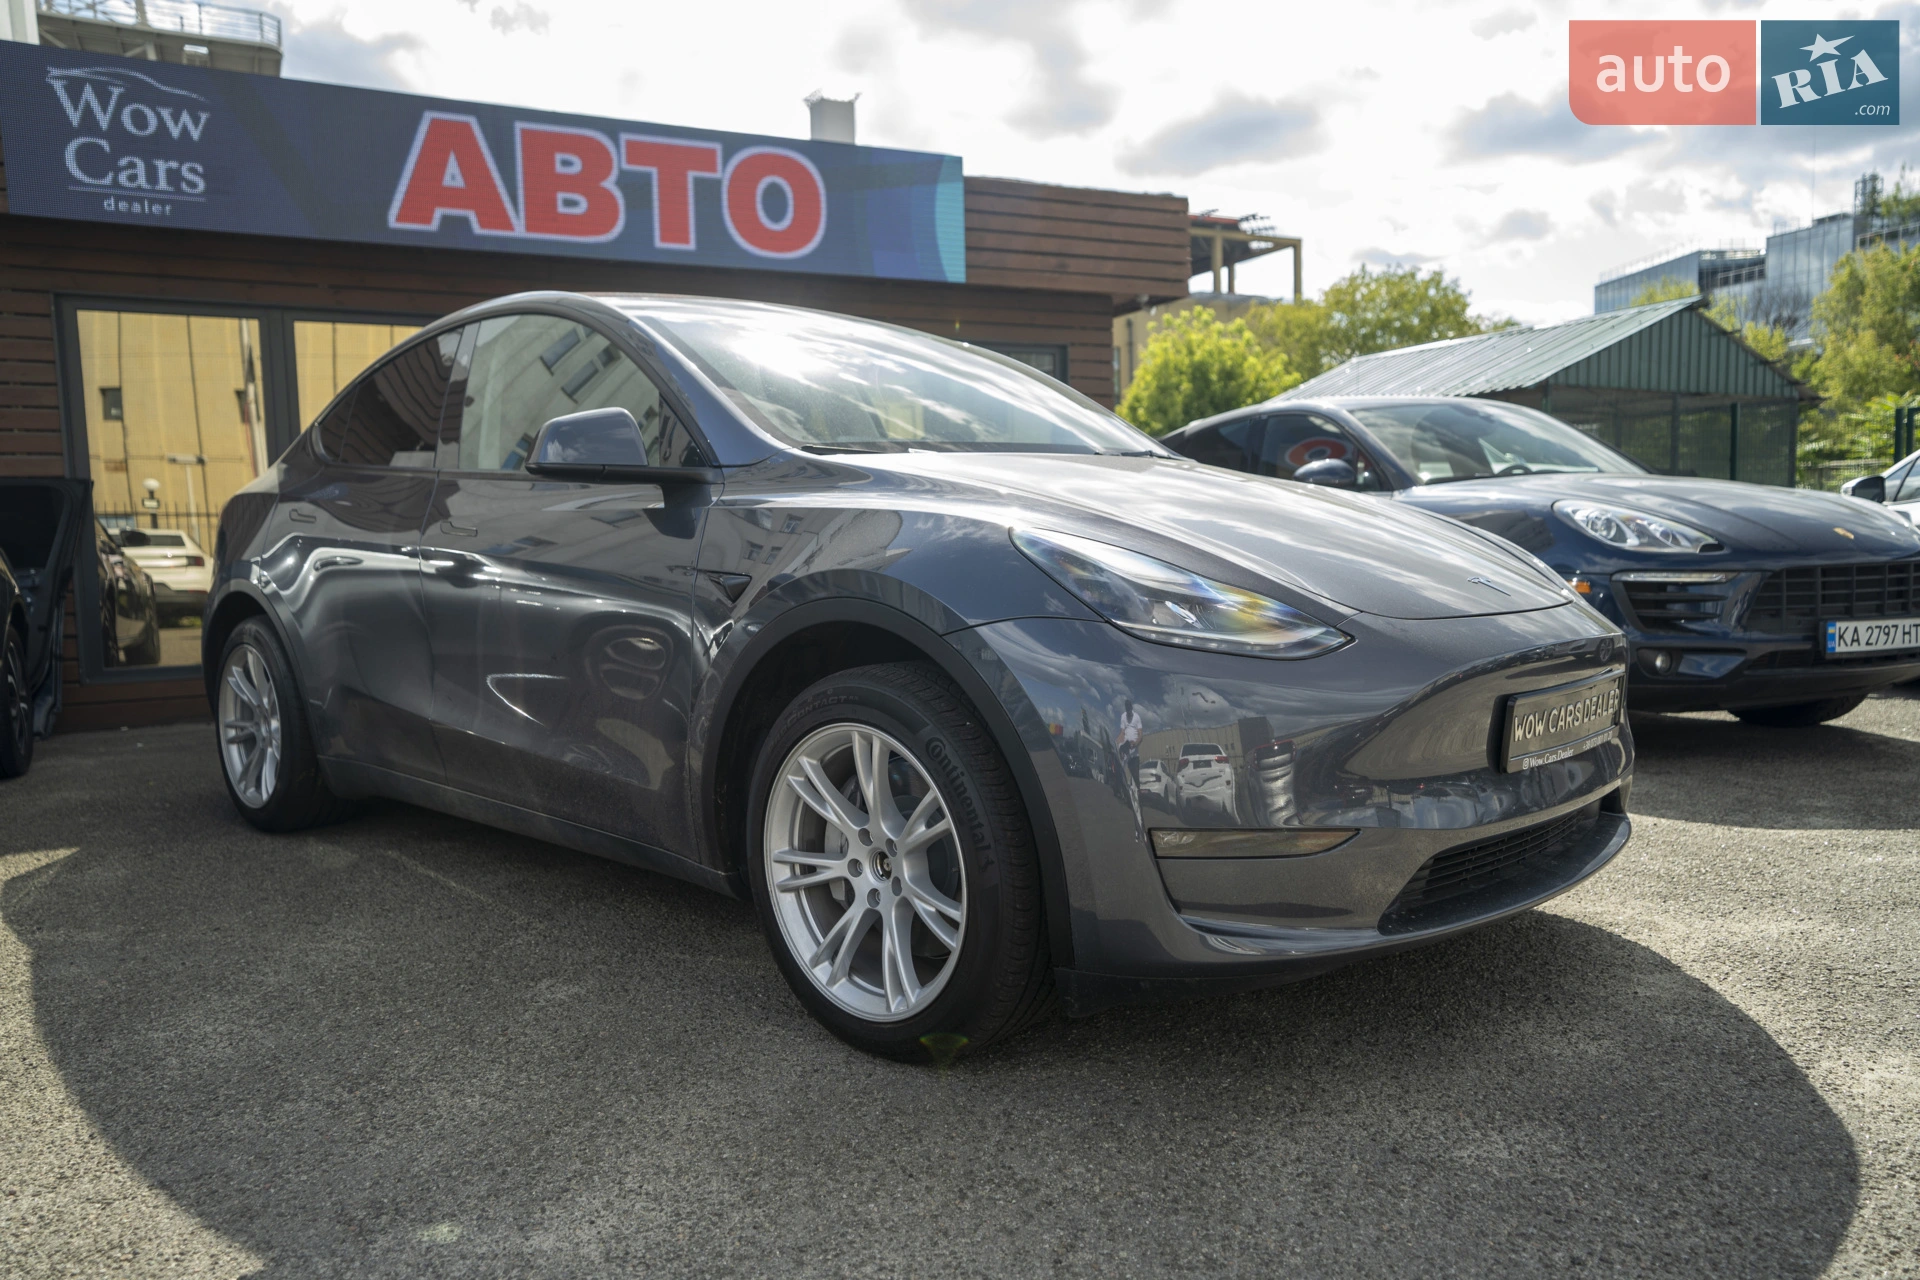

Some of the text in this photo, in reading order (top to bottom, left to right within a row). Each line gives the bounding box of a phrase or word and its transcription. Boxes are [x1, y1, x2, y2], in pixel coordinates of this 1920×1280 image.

[65, 136, 206, 193] Cars
[388, 109, 827, 260] АВТО
[104, 196, 172, 215] dealer
[1838, 624, 1920, 647] KA 2797 HT
[1514, 710, 1547, 741] WOW
[1549, 702, 1582, 733] CARS
[1583, 688, 1620, 723] DEALER
[925, 737, 992, 851] Continental
